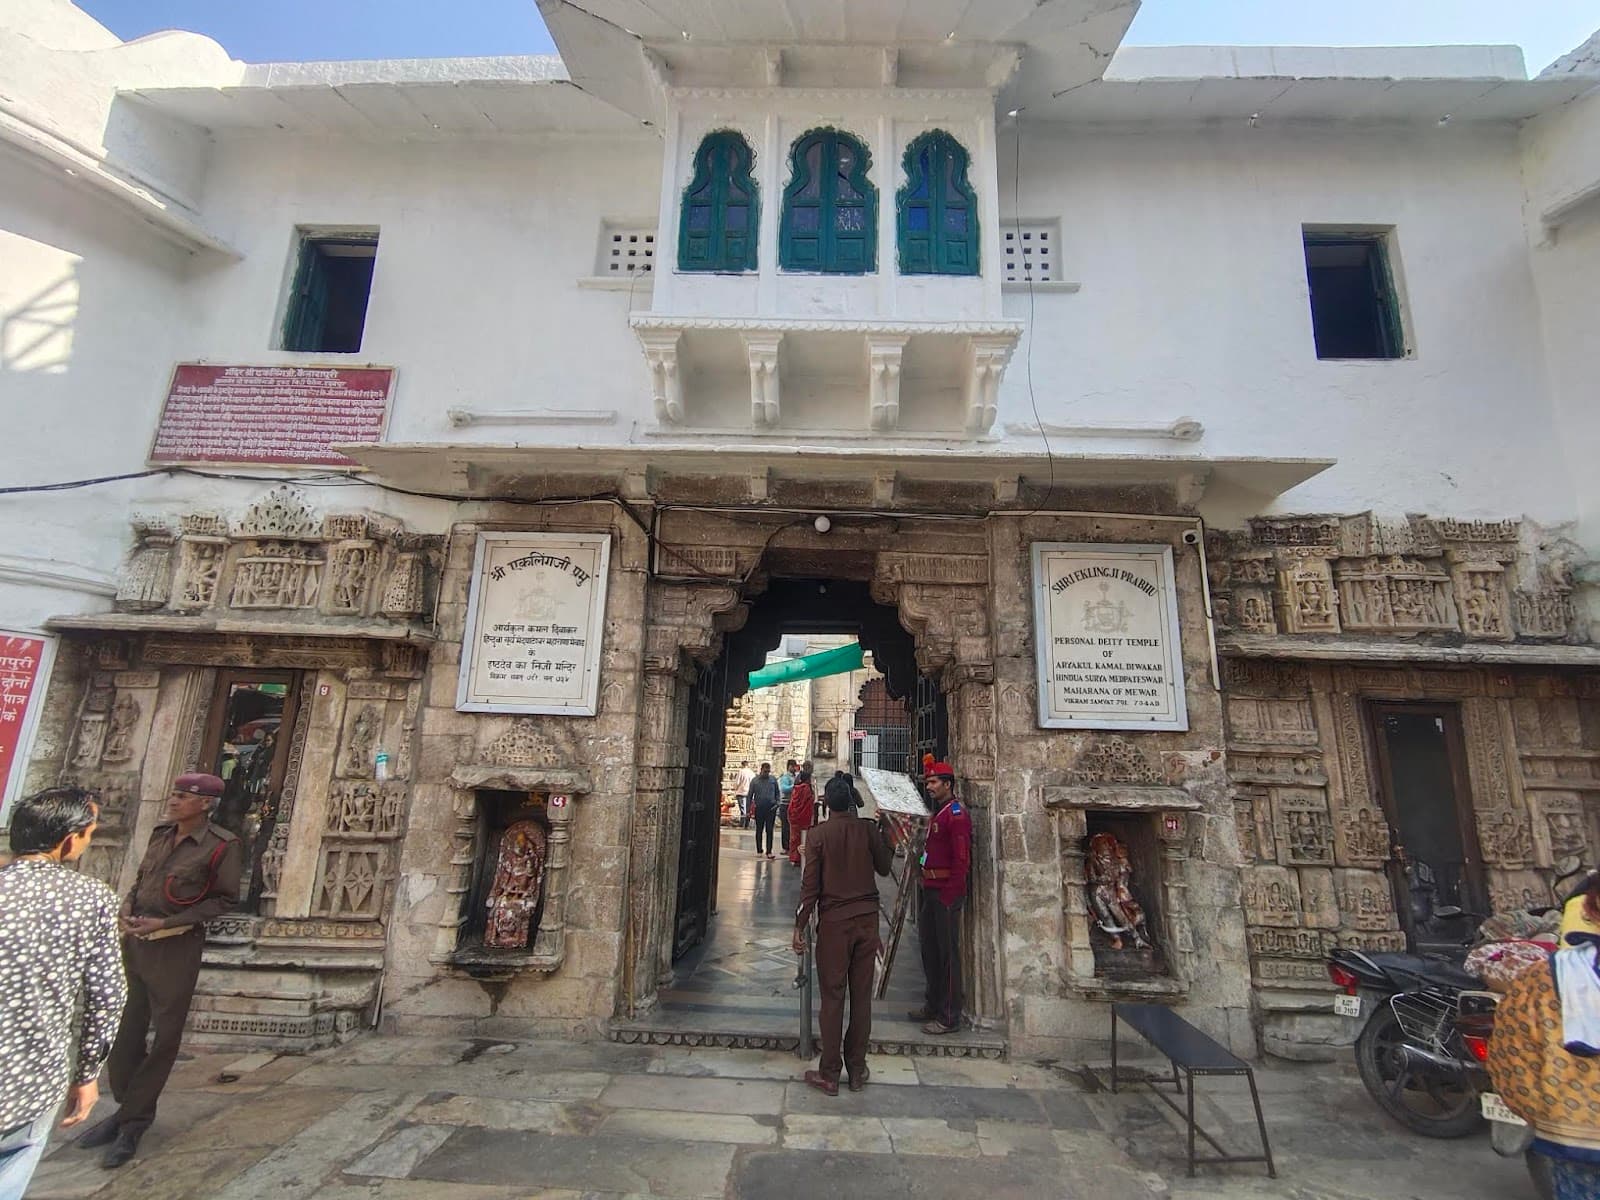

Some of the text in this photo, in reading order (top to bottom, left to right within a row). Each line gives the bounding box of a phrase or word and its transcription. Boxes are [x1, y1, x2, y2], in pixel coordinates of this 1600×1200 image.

[490, 565, 506, 581] श्री
[1051, 566, 1159, 597] SHRI EKLINGJI PRABHU
[1054, 637, 1160, 647] PERSONAL DEITY TEMPLE
[1102, 650, 1114, 658] OF
[515, 661, 528, 669] का
[1055, 662, 1163, 671] ARYAKUL KAMAL DIWAKAR
[1055, 674, 1083, 682] HINDUA
[1085, 674, 1107, 683] SURYA
[1063, 687, 1110, 695] MAHARANA
[1112, 688, 1123, 696] OF
